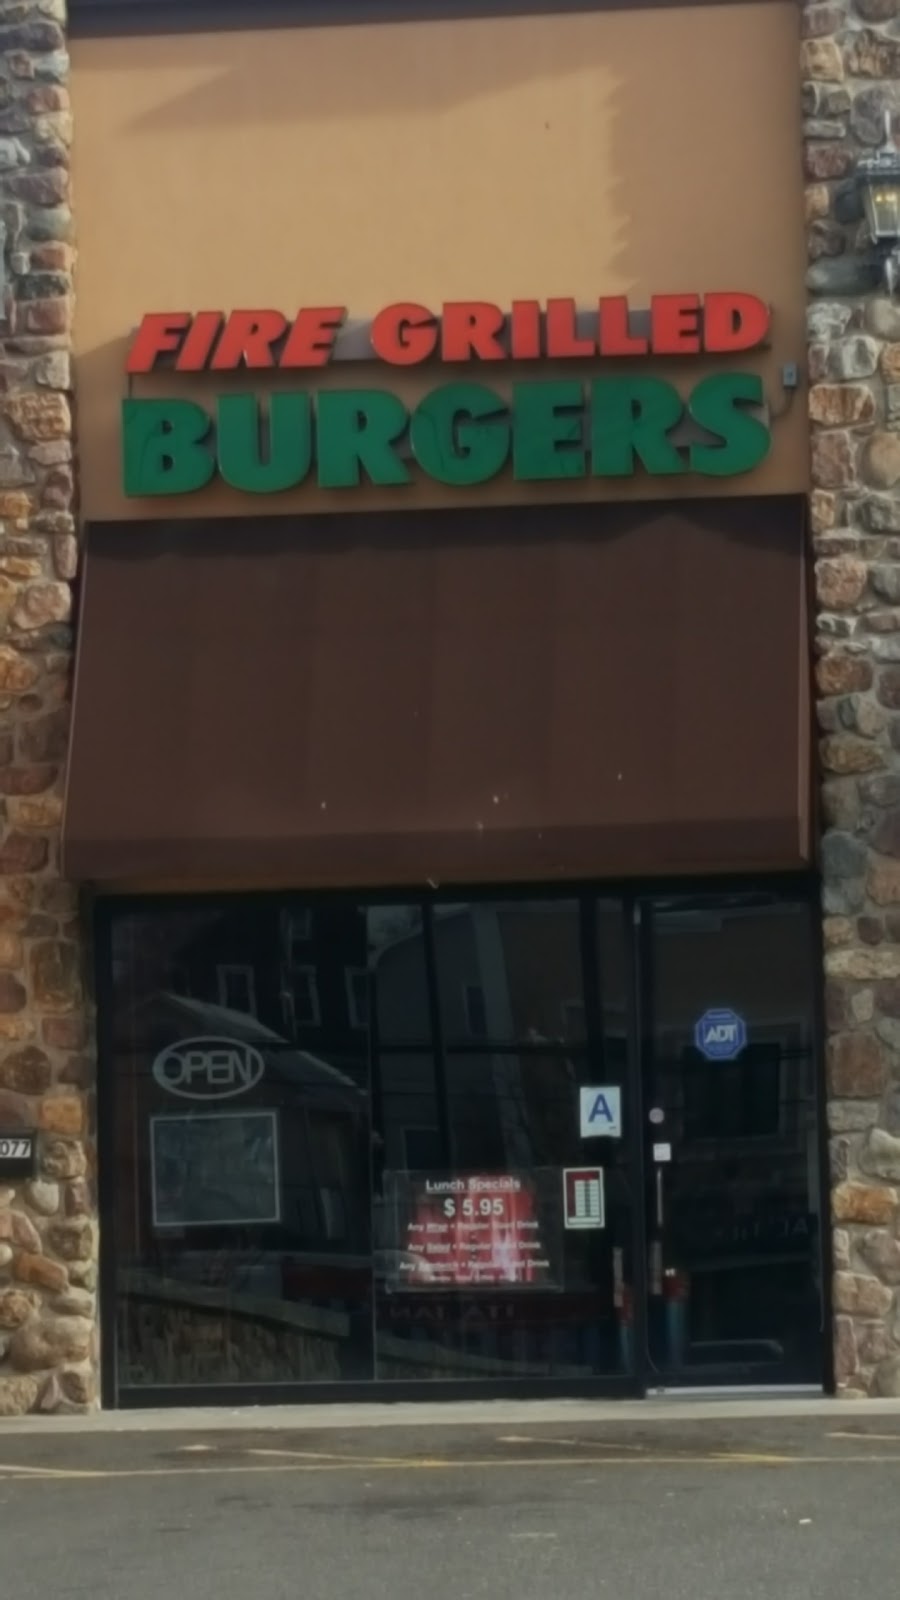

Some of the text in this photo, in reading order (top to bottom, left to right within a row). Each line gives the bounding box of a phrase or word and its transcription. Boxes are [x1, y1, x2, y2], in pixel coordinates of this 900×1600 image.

[126, 292, 771, 373] FIRE GRILLED
[122, 373, 772, 497] BURGERS
[704, 1024, 737, 1043] ADT
[155, 1050, 251, 1086] OPEN
[588, 1093, 613, 1123] A
[425, 1177, 521, 1191] Lunch Specials
[462, 1199, 504, 1216] 5.95
